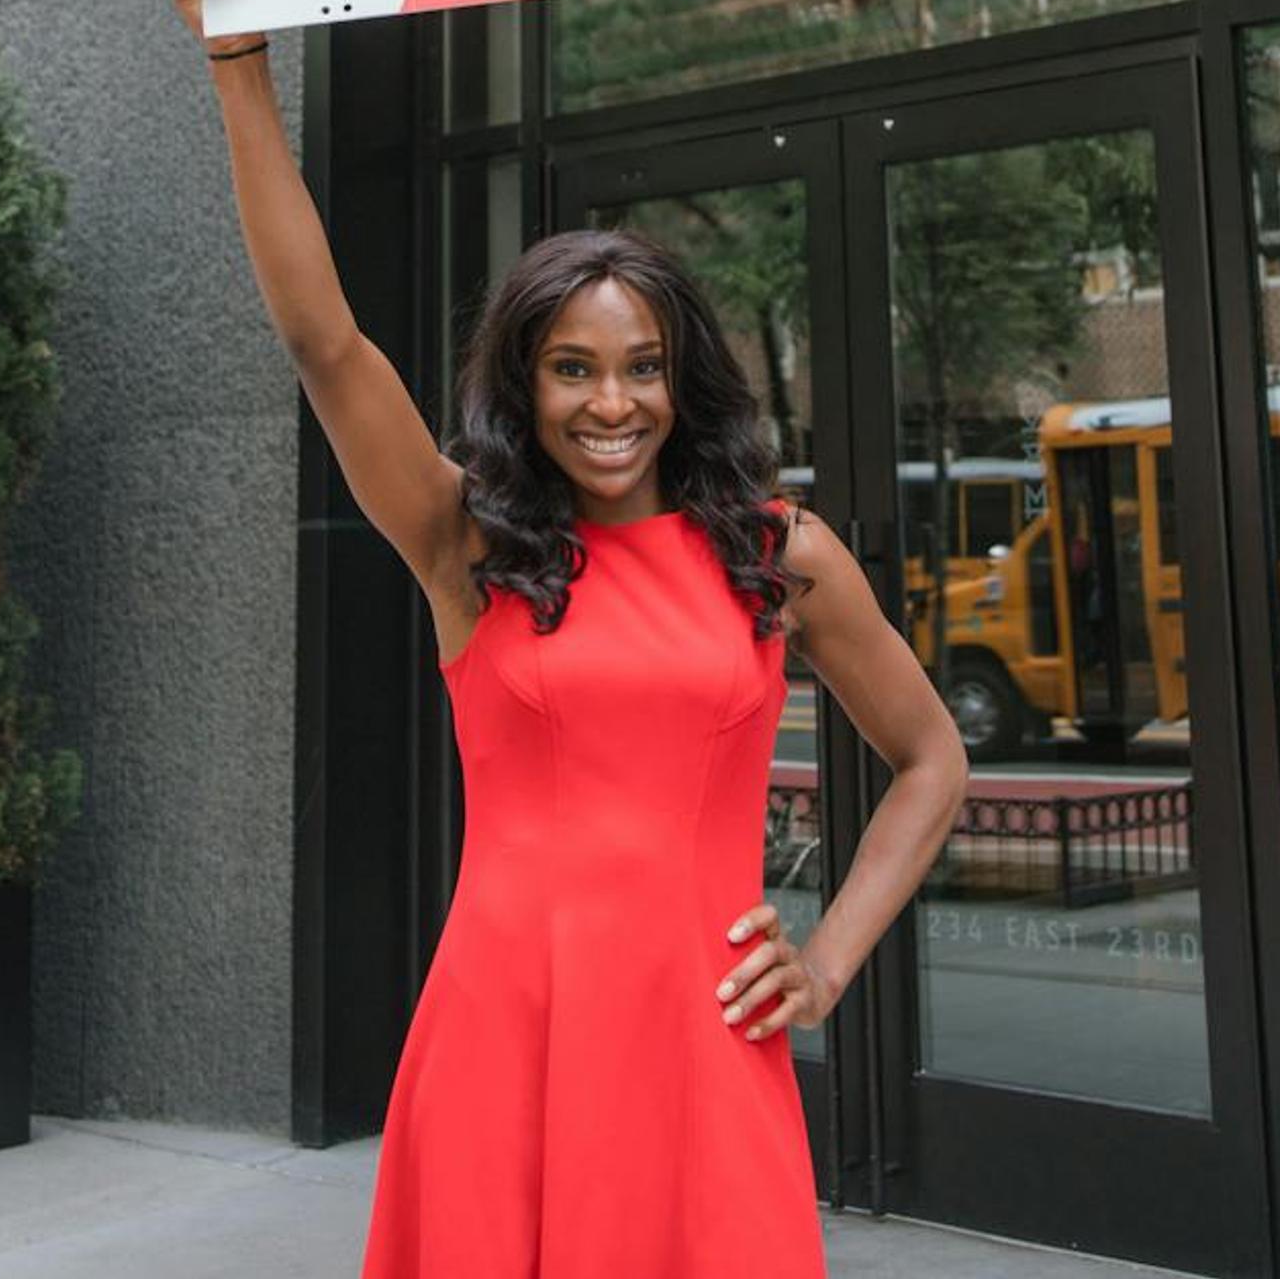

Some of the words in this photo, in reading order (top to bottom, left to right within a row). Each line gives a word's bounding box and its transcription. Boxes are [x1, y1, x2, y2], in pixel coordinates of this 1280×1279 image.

[927, 910, 983, 942] 234
[1005, 916, 1081, 953] EAST
[1106, 927, 1199, 964] 23RD
